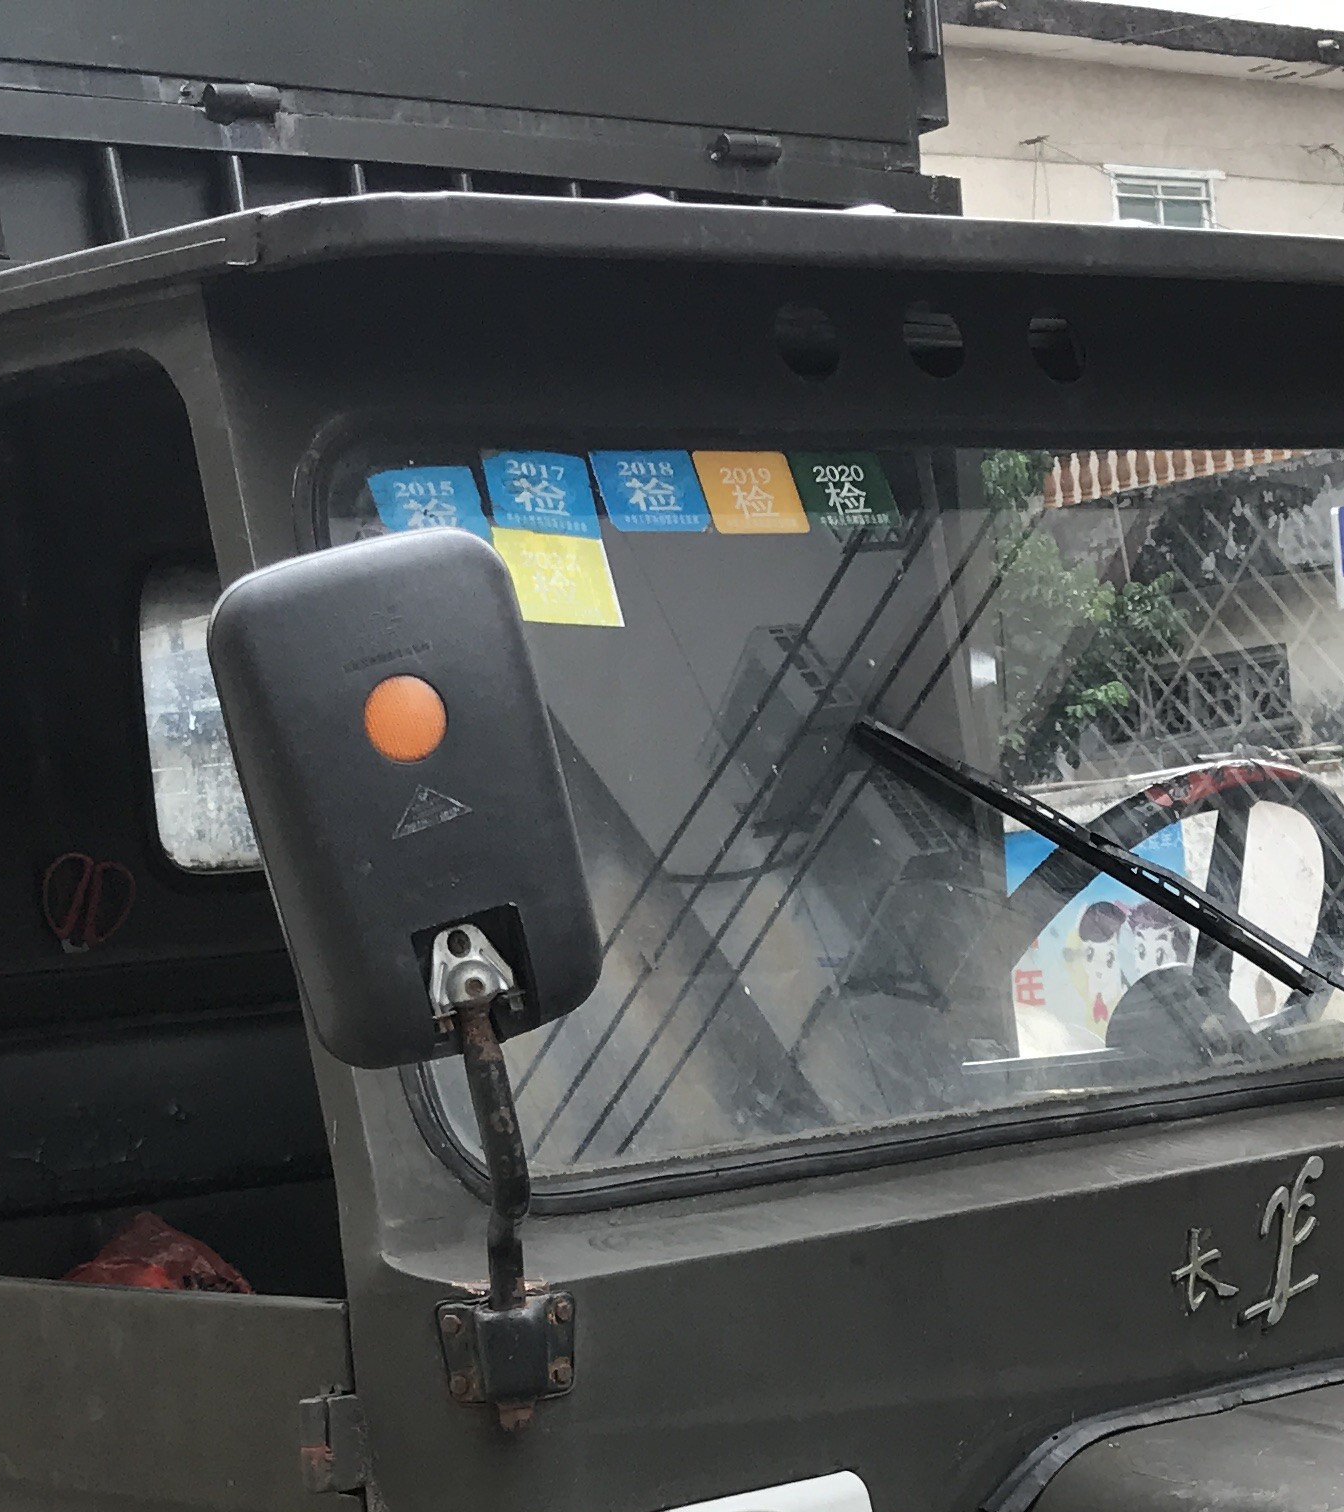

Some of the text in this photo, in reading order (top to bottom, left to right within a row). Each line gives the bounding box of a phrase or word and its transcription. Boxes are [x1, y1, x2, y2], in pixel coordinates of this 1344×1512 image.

[506, 458, 565, 481] 2017
[617, 460, 674, 477] 2018
[719, 466, 772, 485] 2019
[812, 464, 865, 483] 2020
[393, 480, 455, 498] 2015
[513, 477, 571, 517] 检
[625, 477, 683, 512] 检
[824, 481, 873, 516] 检
[731, 484, 780, 519] 检
